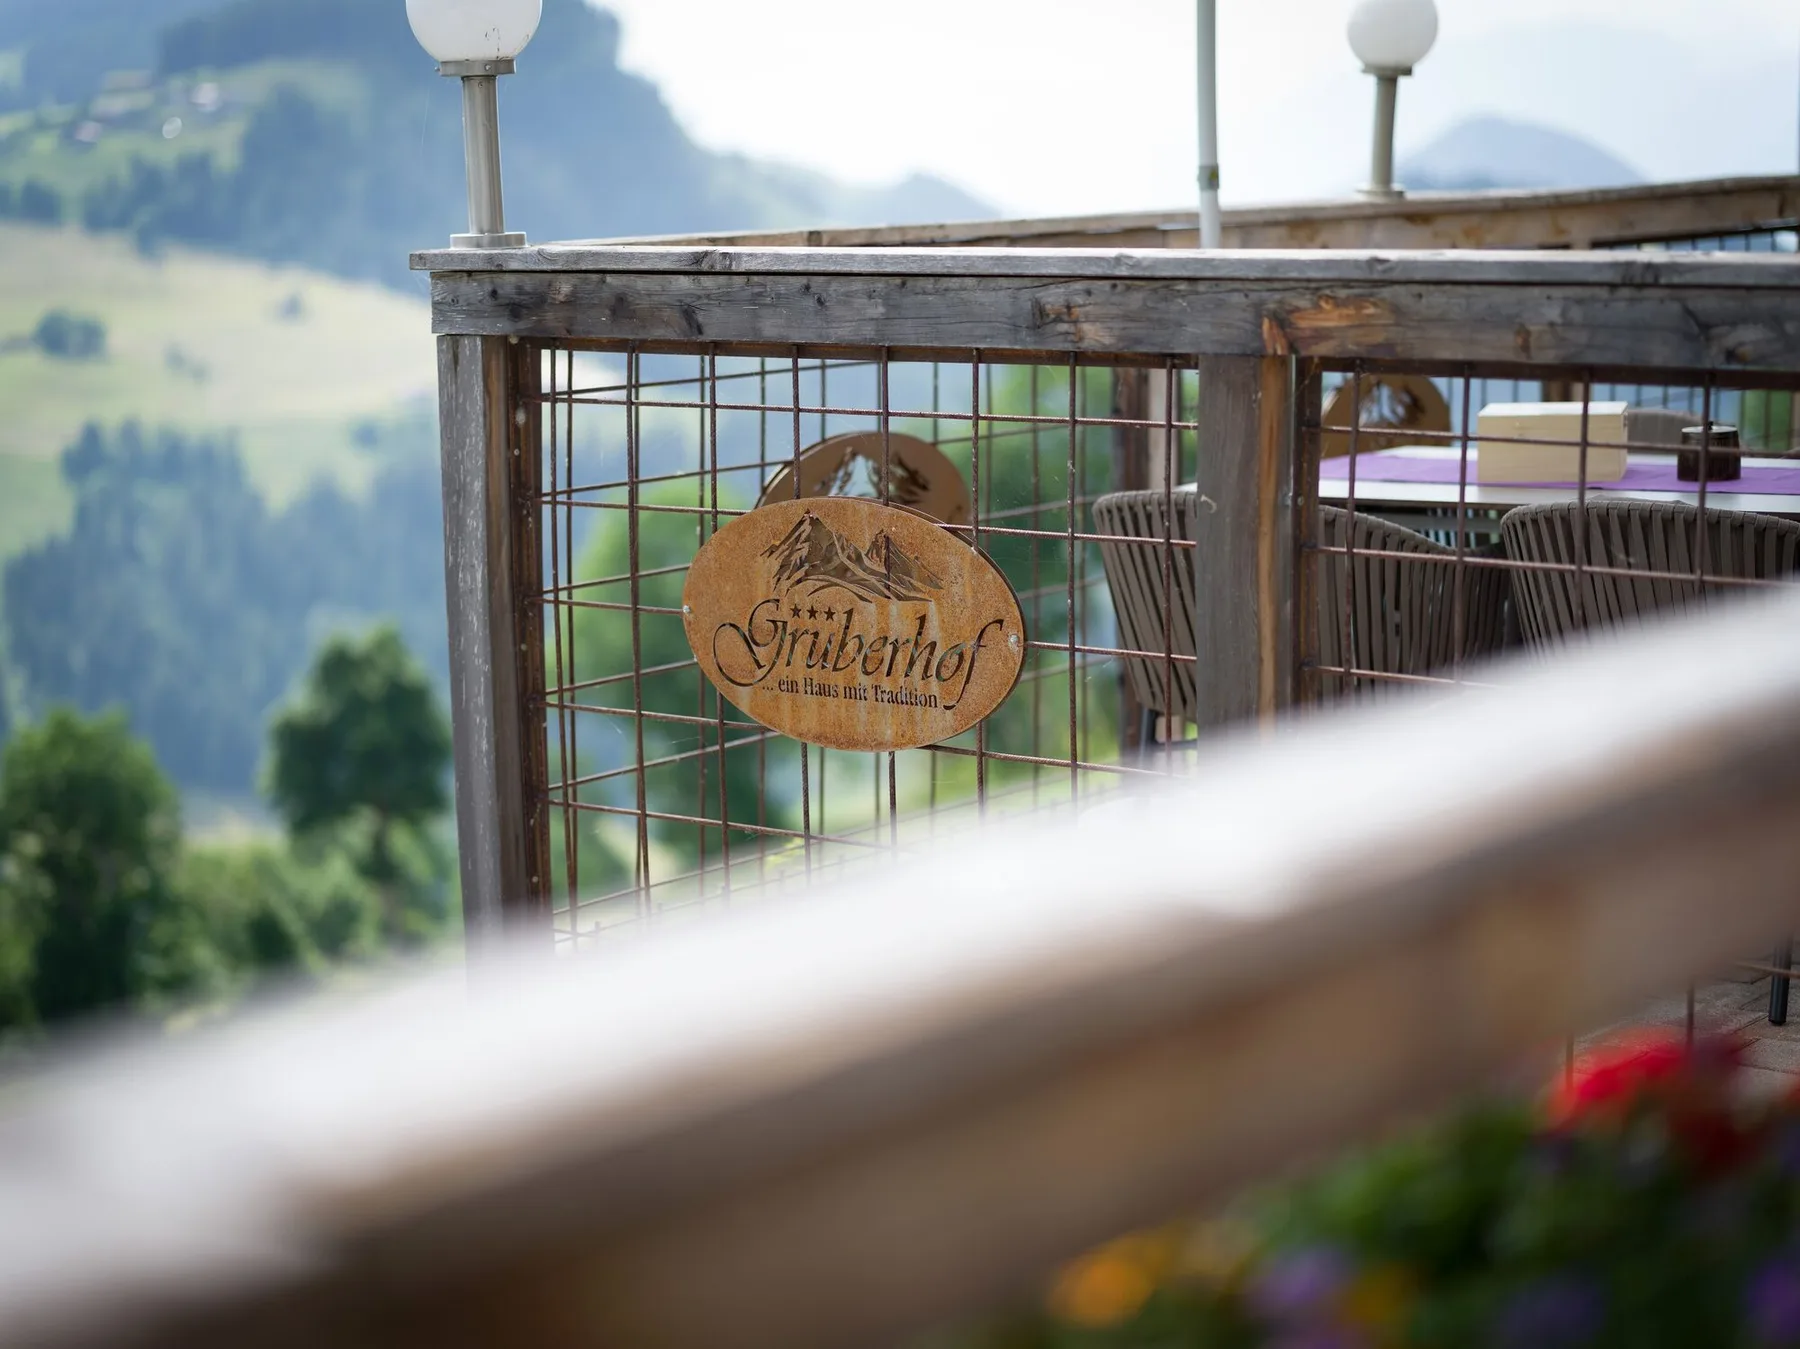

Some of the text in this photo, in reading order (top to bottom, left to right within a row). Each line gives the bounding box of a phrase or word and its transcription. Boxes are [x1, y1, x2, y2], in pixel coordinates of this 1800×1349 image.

[713, 599, 1003, 710] Gruberhof
[778, 676, 799, 694] ein
[804, 677, 839, 699] Haus
[843, 683, 868, 702] mit
[871, 684, 938, 708] Tradition
